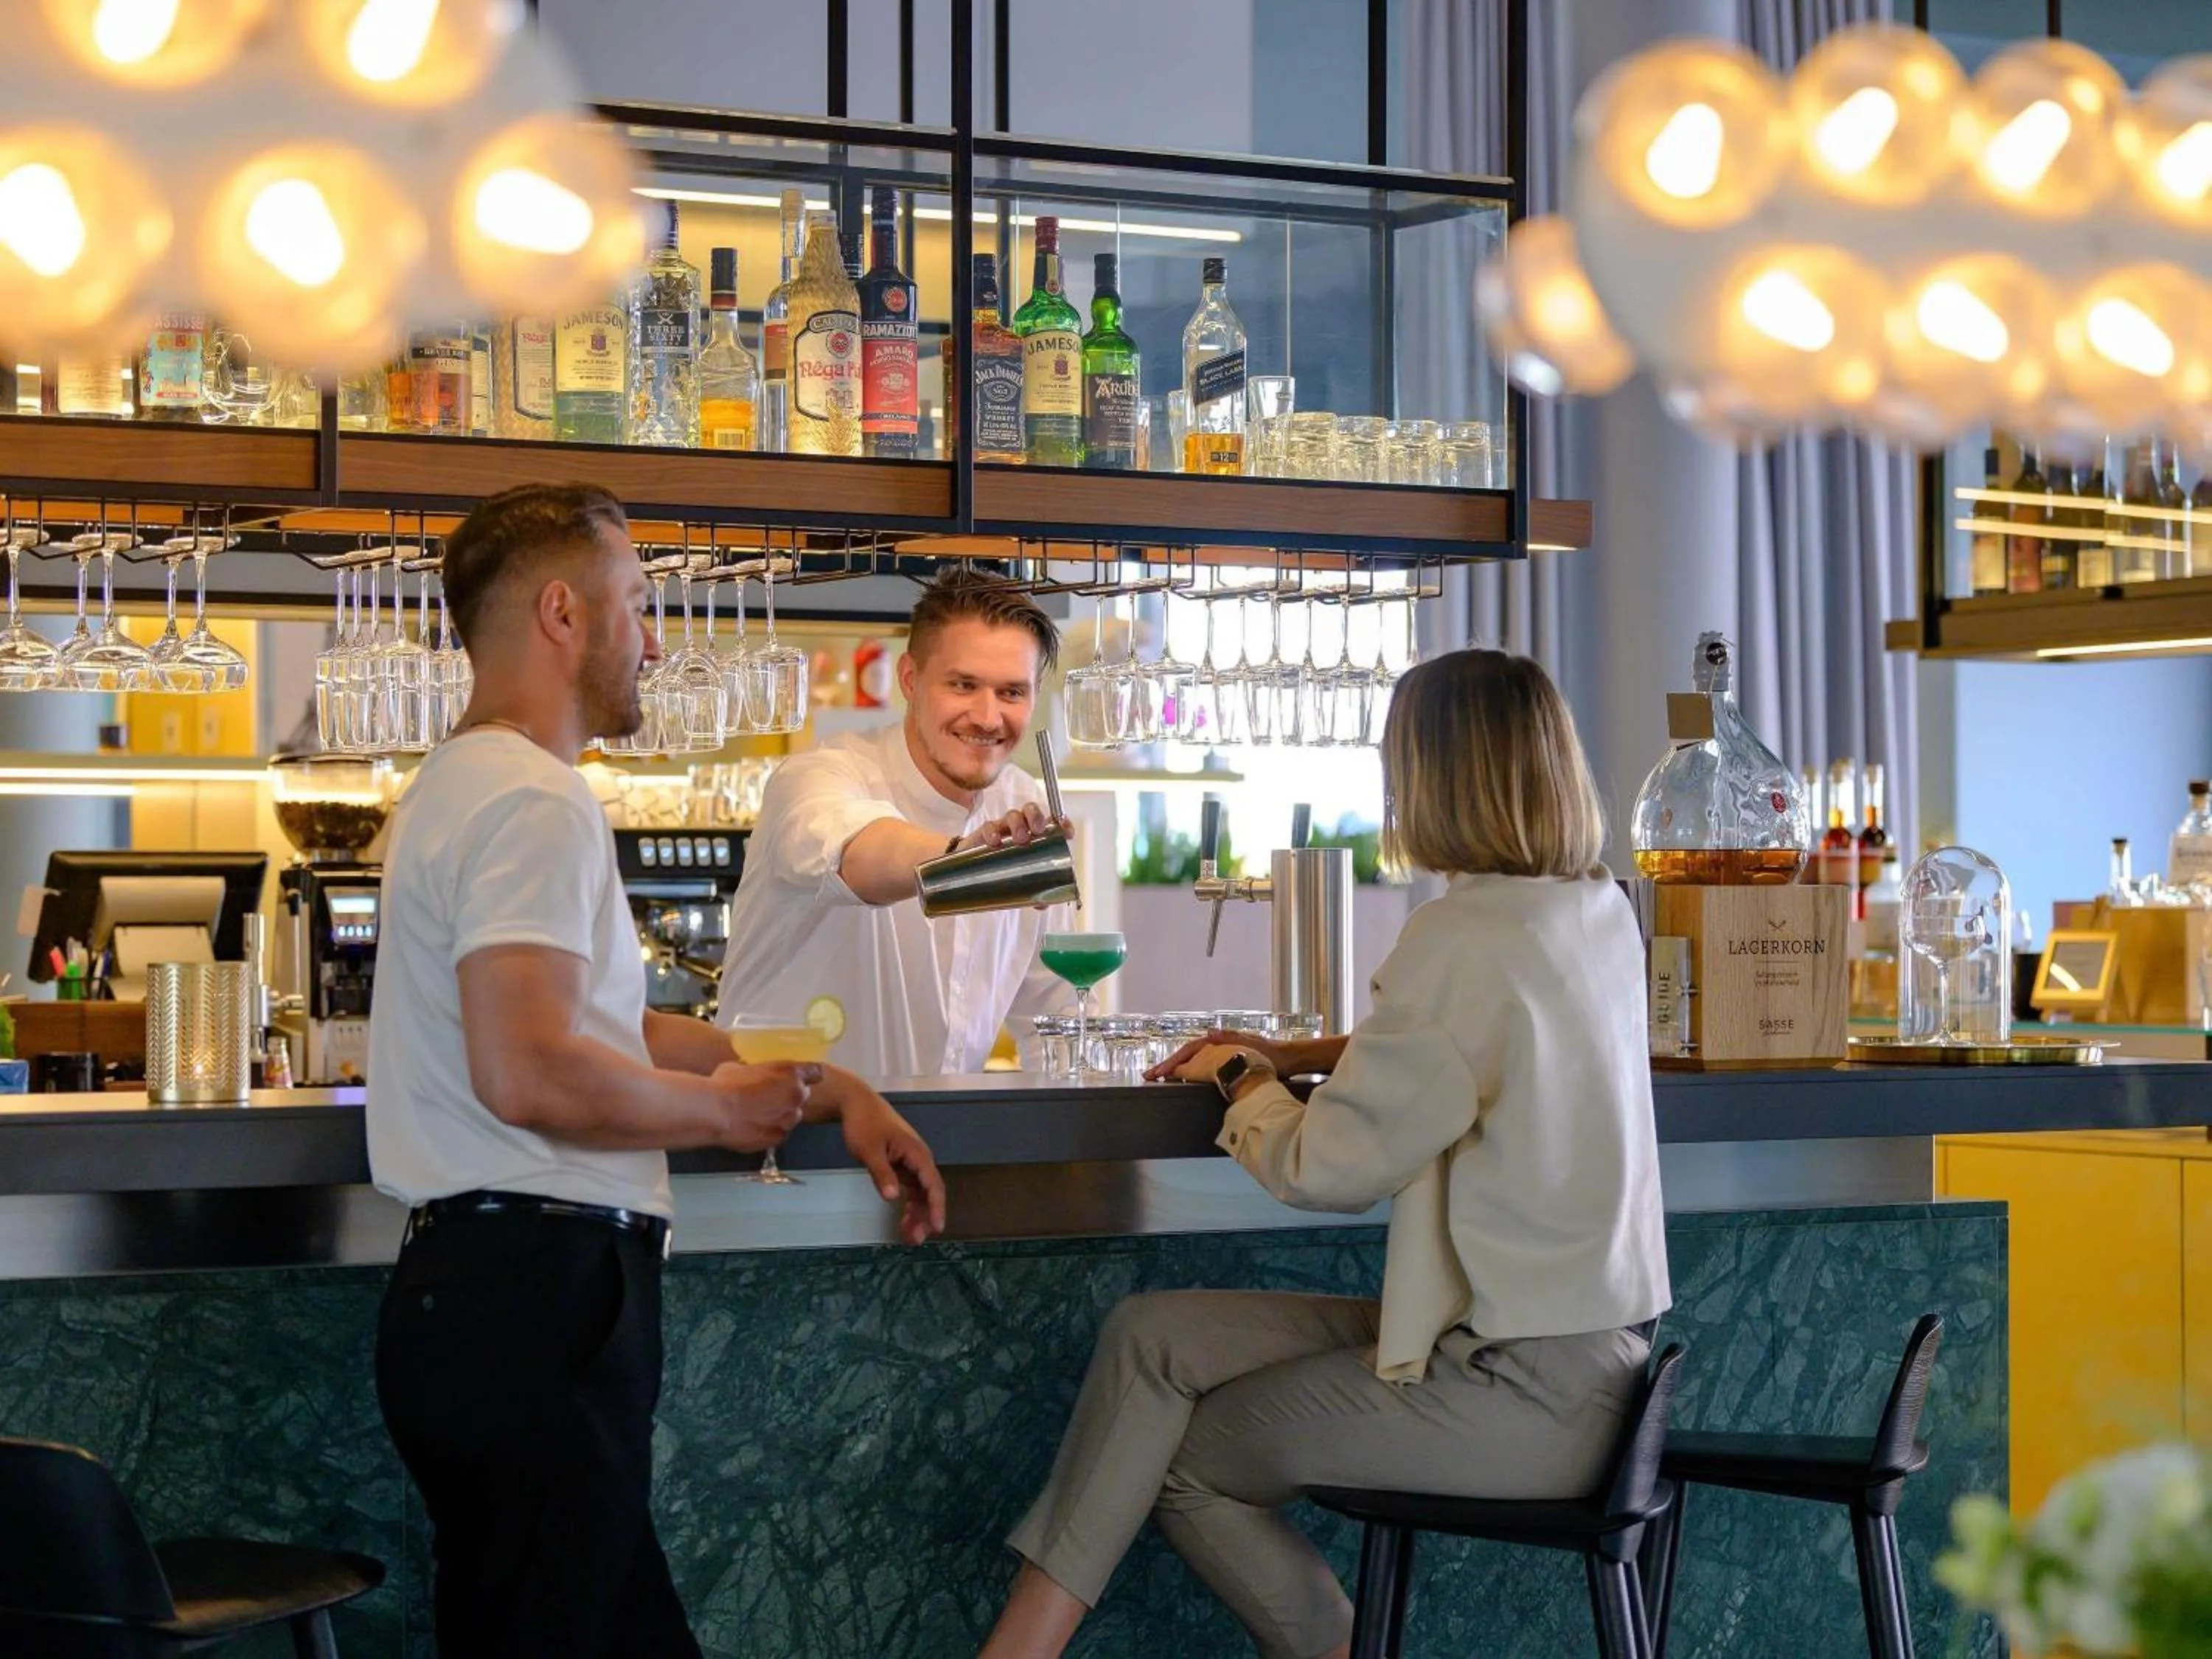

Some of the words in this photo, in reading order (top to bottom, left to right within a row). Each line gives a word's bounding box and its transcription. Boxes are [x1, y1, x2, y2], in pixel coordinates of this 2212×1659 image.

[1027, 337, 1080, 355] JAMESO
[1220, 453, 1229, 462] 12
[1728, 939, 1825, 955] LAGERKORN
[1658, 972, 1671, 1023] GUIDE
[1759, 1019, 1795, 1030] SASSE
